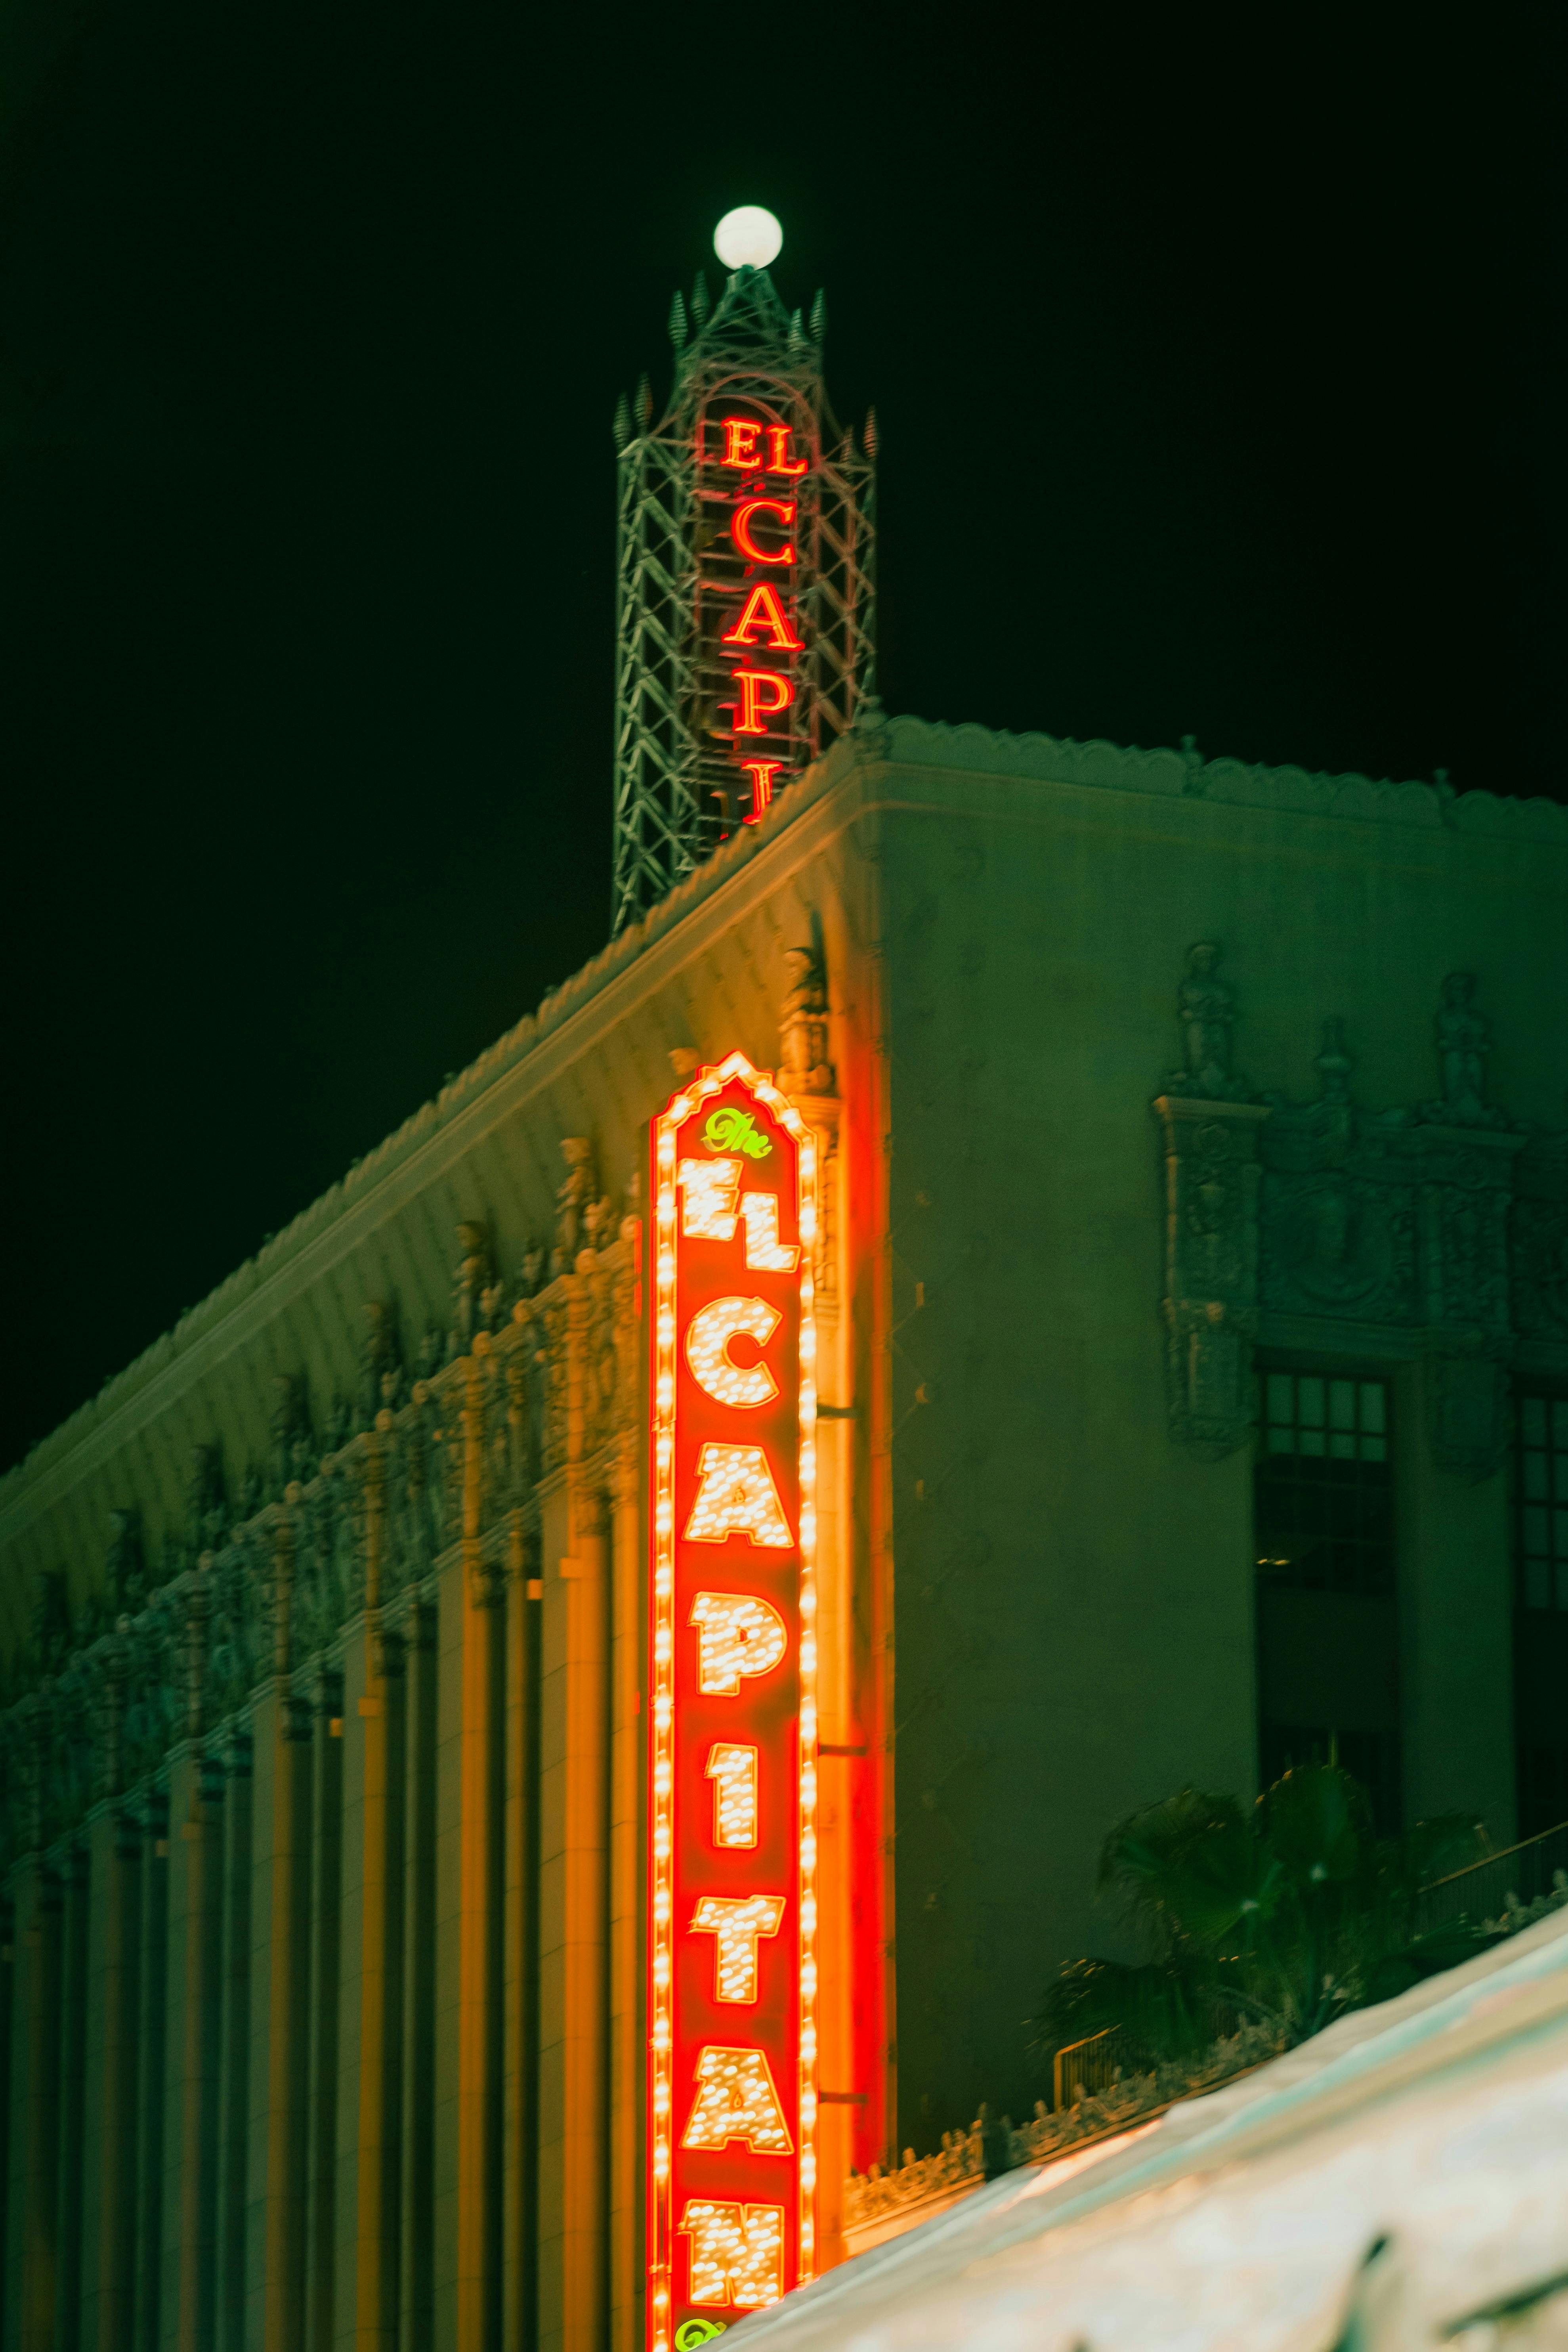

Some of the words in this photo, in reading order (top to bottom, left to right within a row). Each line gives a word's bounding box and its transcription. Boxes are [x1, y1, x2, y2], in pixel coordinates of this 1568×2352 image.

[721, 417, 807, 475] EL
[700, 1107, 773, 1159] The
[677, 1157, 801, 1274] EL
[678, 1296, 795, 2309] CAPITAN
